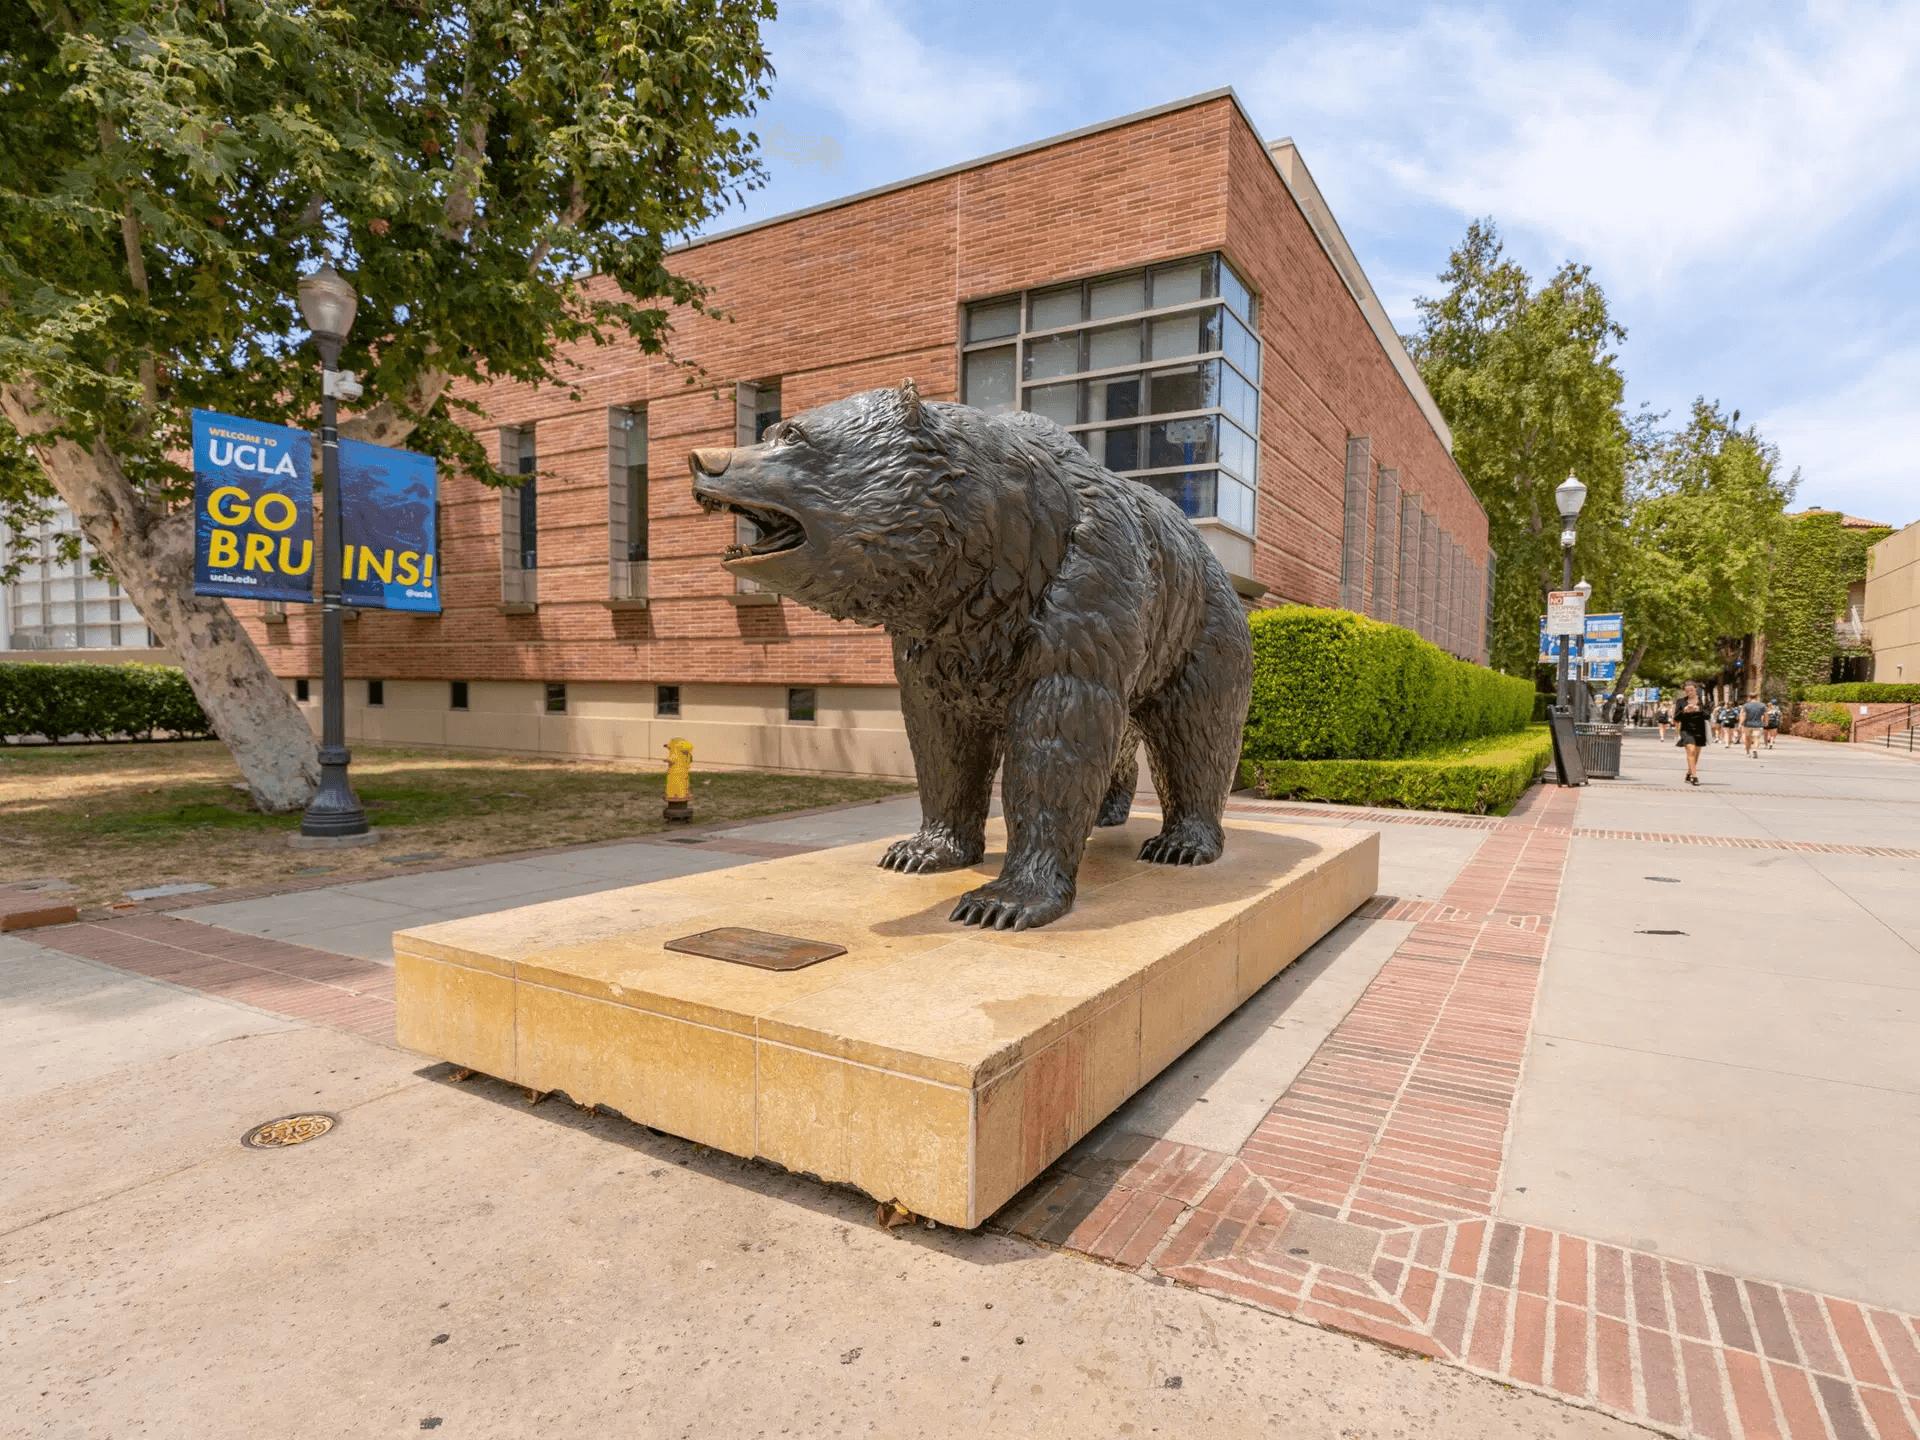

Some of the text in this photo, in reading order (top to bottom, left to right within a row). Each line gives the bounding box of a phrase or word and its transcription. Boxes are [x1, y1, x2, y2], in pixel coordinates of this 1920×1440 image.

[208, 427, 278, 447] WELCOME TO
[208, 439, 298, 478] UCLA
[207, 486, 298, 532] GO
[209, 573, 257, 585] ucla.edu
